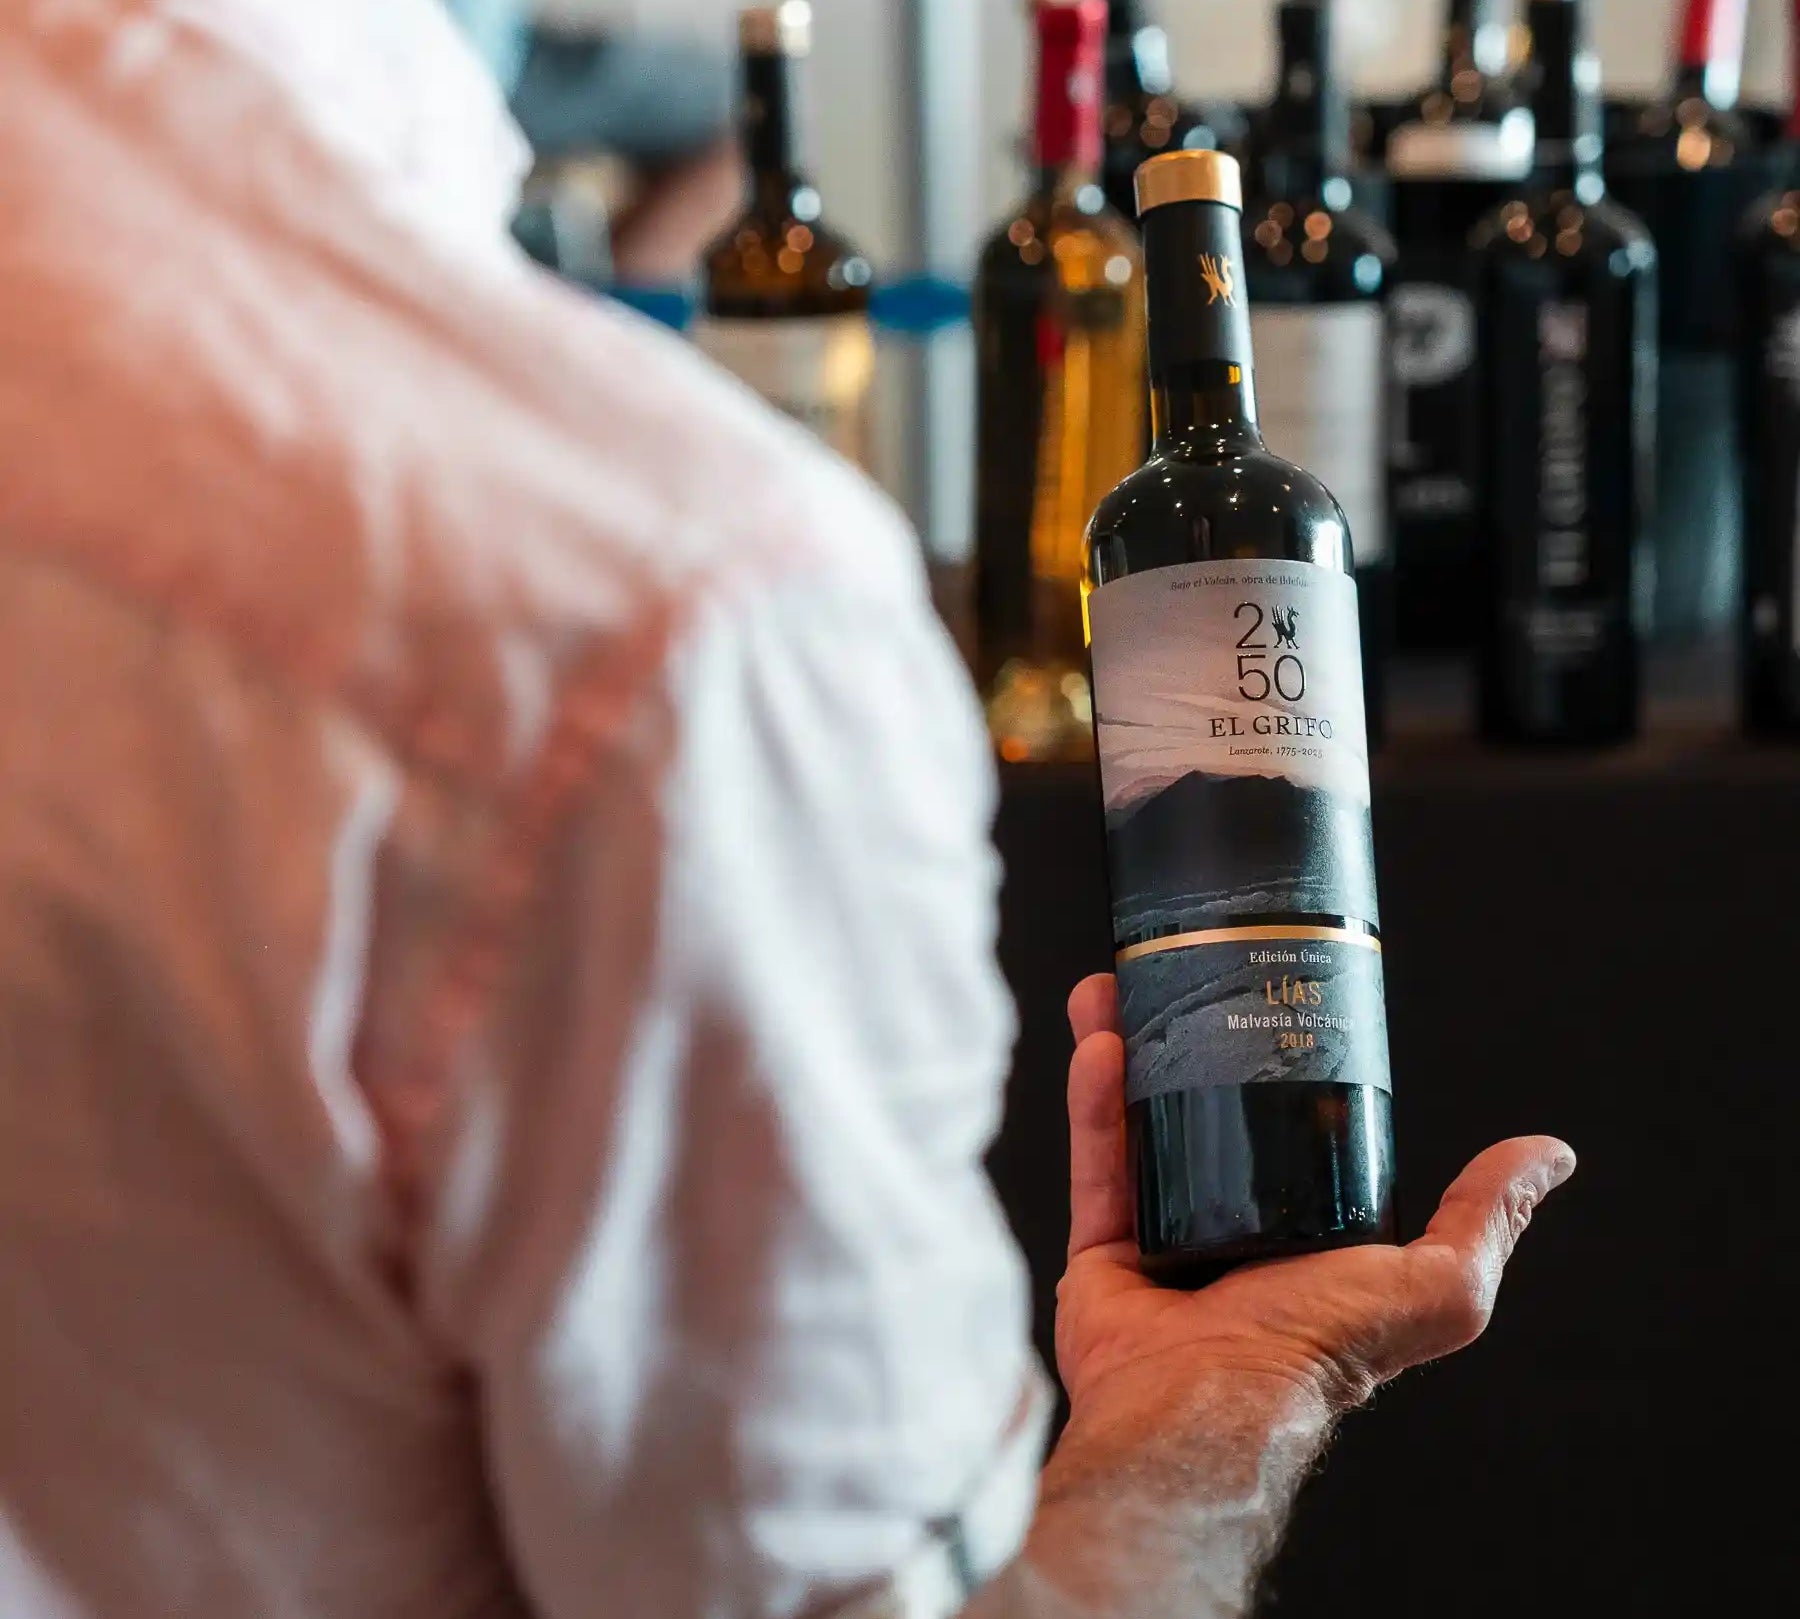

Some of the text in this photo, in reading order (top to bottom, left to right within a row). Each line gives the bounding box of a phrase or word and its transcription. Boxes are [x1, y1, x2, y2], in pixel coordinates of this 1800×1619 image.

[1170, 580, 1191, 592] Bajo
[1194, 579, 1202, 588] el
[1241, 575, 1264, 584] obra
[1265, 575, 1277, 584] de
[1233, 602, 1267, 650] 2
[1237, 653, 1307, 702] 50
[1208, 715, 1333, 739] EL GRIFO
[1228, 745, 1273, 756] Lanzarote,
[1249, 950, 1332, 964] Edición Única
[1265, 975, 1323, 1006] LÍAS
[1227, 1012, 1292, 1030] Malvasía
[1280, 1032, 1314, 1049] 2018
